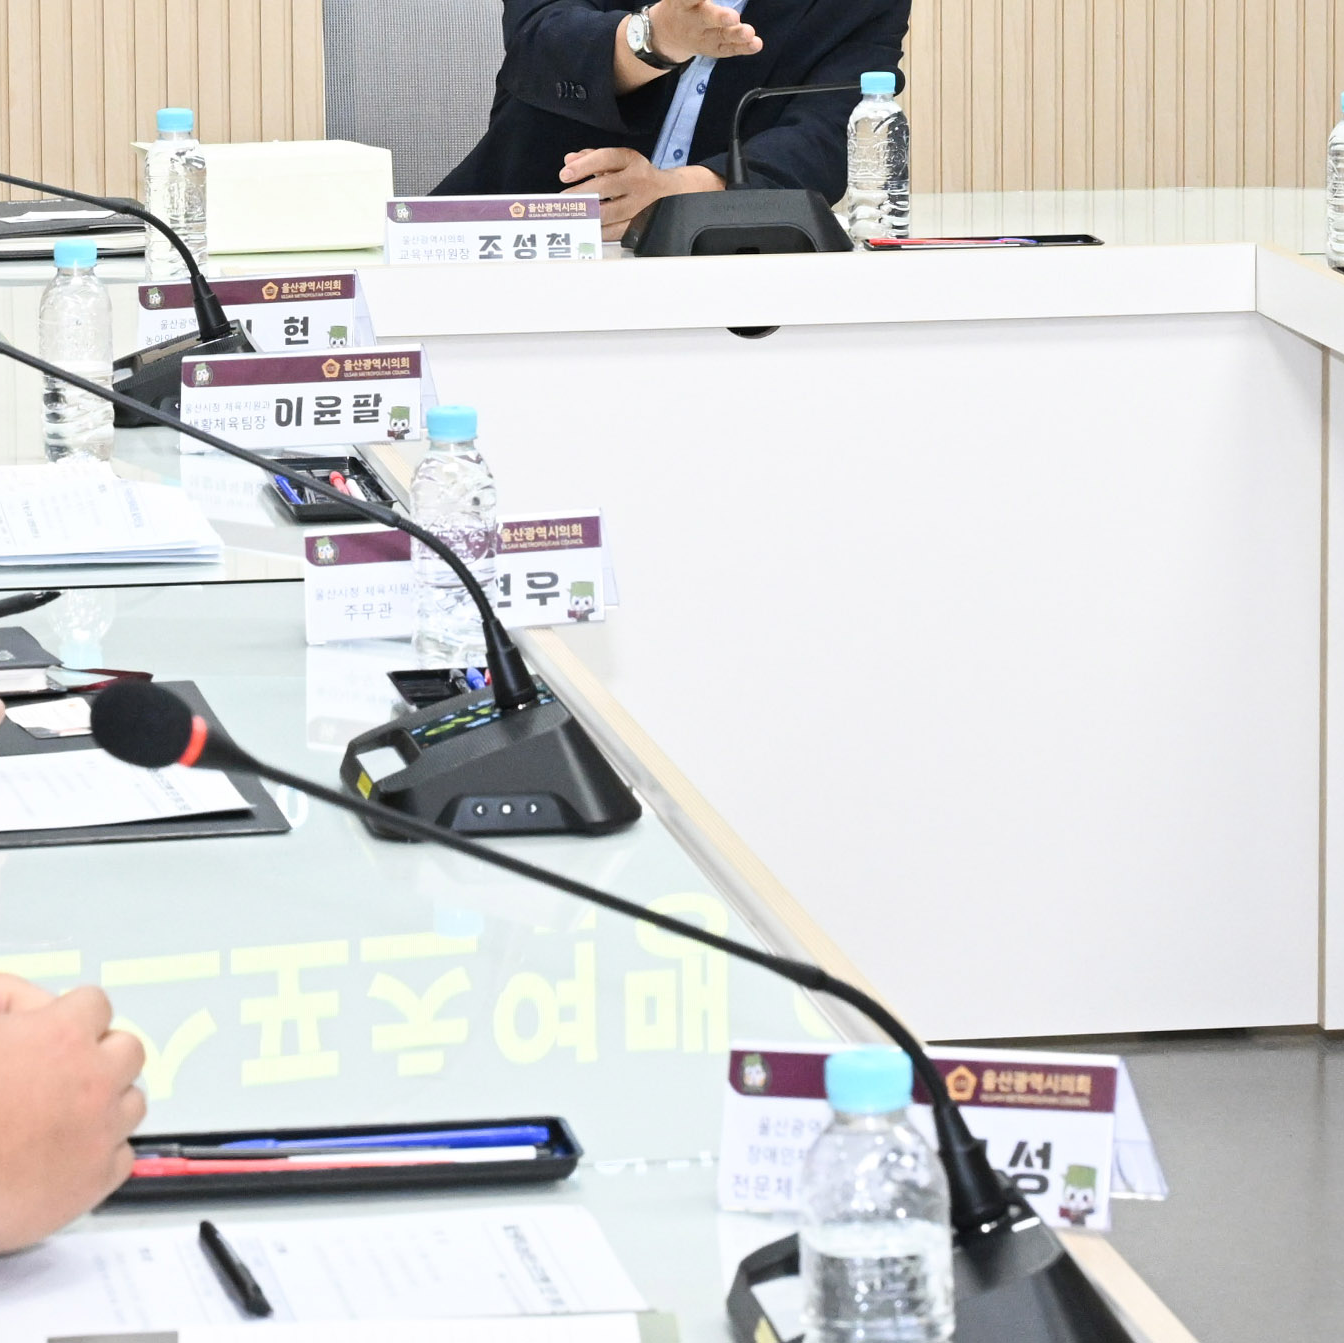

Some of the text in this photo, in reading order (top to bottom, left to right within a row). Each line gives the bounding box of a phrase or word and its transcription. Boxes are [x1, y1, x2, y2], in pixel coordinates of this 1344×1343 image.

[528, 202, 587, 212] 울산광역시의회
[402, 235, 465, 244] 울산광역시의회
[281, 280, 342, 293] 울산광역시의회
[160, 318, 197, 330] 울산광역
[343, 357, 410, 371] 울산광역시의회
[501, 524, 583, 543] 울산광역시의회
[344, 602, 393, 621] 주무관
